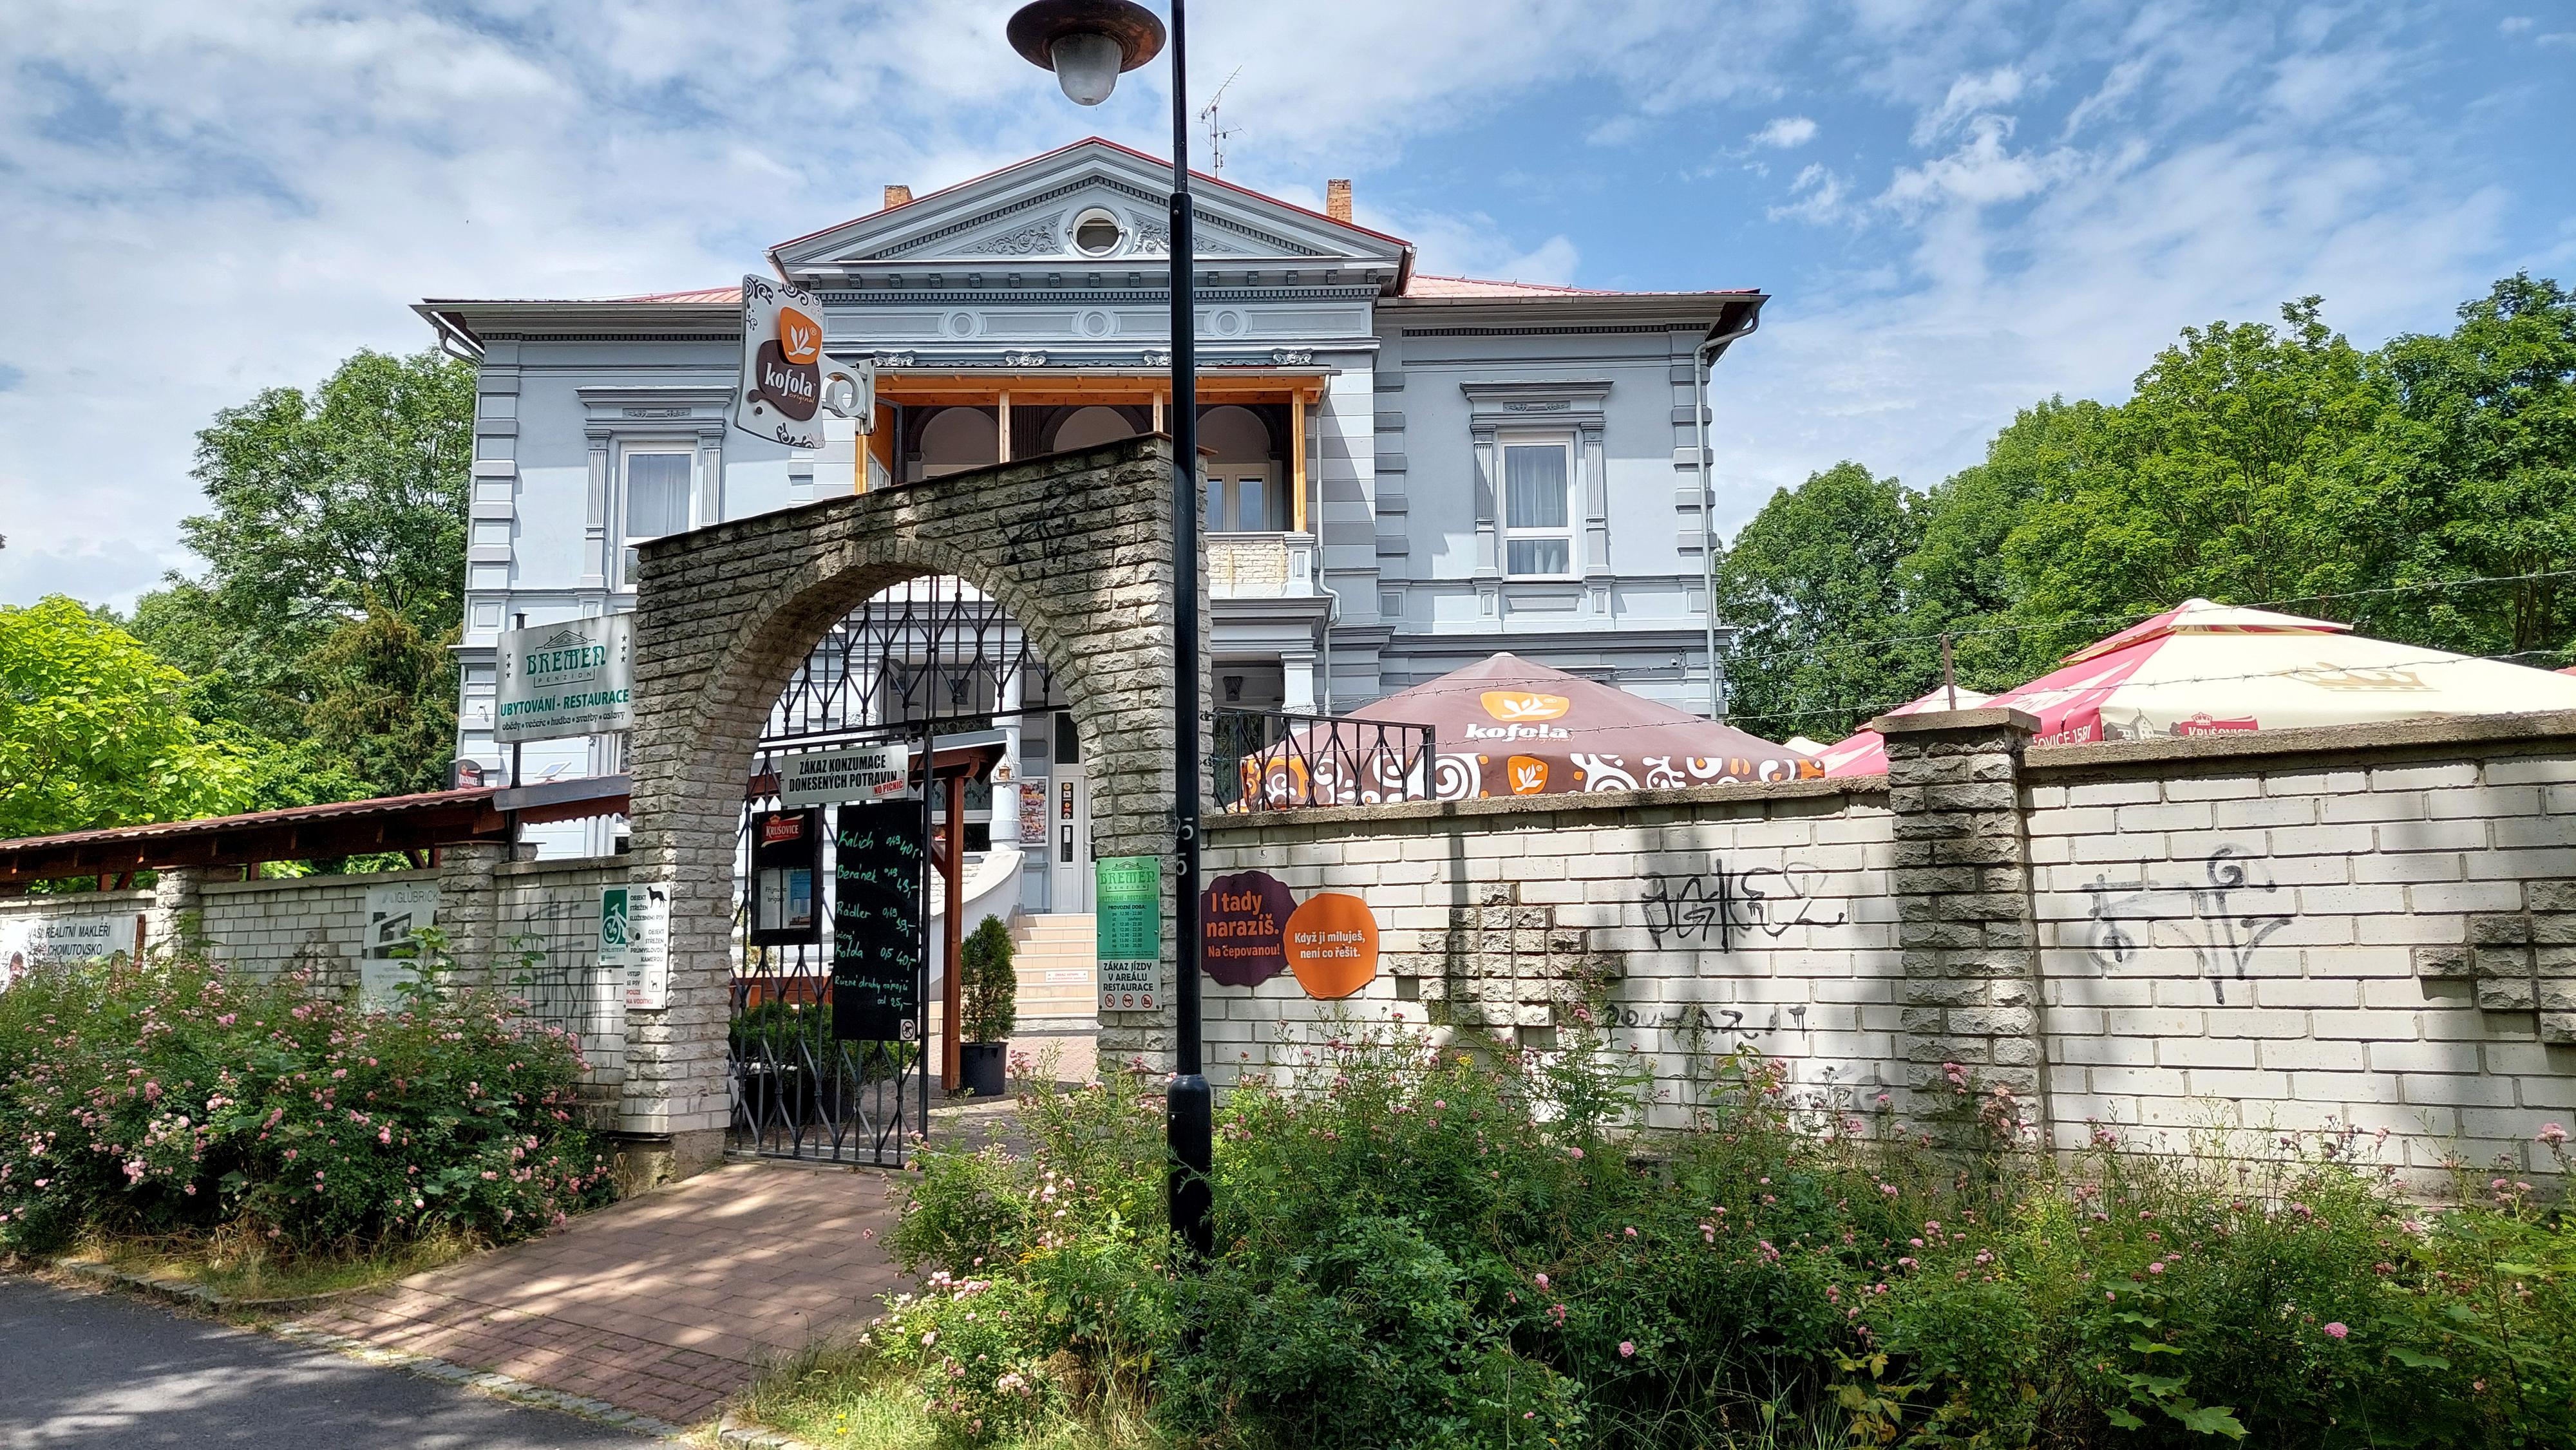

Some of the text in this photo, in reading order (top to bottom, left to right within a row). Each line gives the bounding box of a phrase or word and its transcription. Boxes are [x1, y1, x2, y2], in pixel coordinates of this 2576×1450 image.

[764, 362, 812, 397] kofola
[789, 392, 815, 404] original
[526, 646, 606, 675] BREMEN
[538, 672, 591, 683] PENZION
[500, 695, 555, 716] UBYTOVÁNÍ
[564, 689, 629, 709] RESTAURACE
[551, 715, 571, 726] hudba
[576, 713, 598, 724] svatby
[603, 710, 625, 720] oslavy
[1464, 724, 1568, 742] kofola
[2072, 724, 2092, 744] 1581
[800, 755, 886, 775] ZÁKAZ KONZUMACE
[790, 771, 897, 792] DONESENÝCH POTRAVIN
[874, 780, 903, 795] NO PICNIC
[838, 830, 873, 849] Kalich
[1100, 871, 1155, 884] BREMEN
[1211, 890, 1262, 915] I tady
[46, 923, 77, 938] REALITNÍ
[79, 922, 111, 937] MAKLÉŘI
[1206, 913, 1279, 937] narazíš.
[1294, 930, 1365, 945] Když ji miluješ,
[48, 943, 102, 956] CHOMUTOVSKO
[1208, 943, 1280, 958] Na čepovanou!
[1300, 948, 1320, 958] není
[1335, 946, 1360, 958] řešit.
[1104, 961, 1152, 971] ZÁKAZ JÍZDY
[1108, 972, 1147, 981] V AREÁLU
